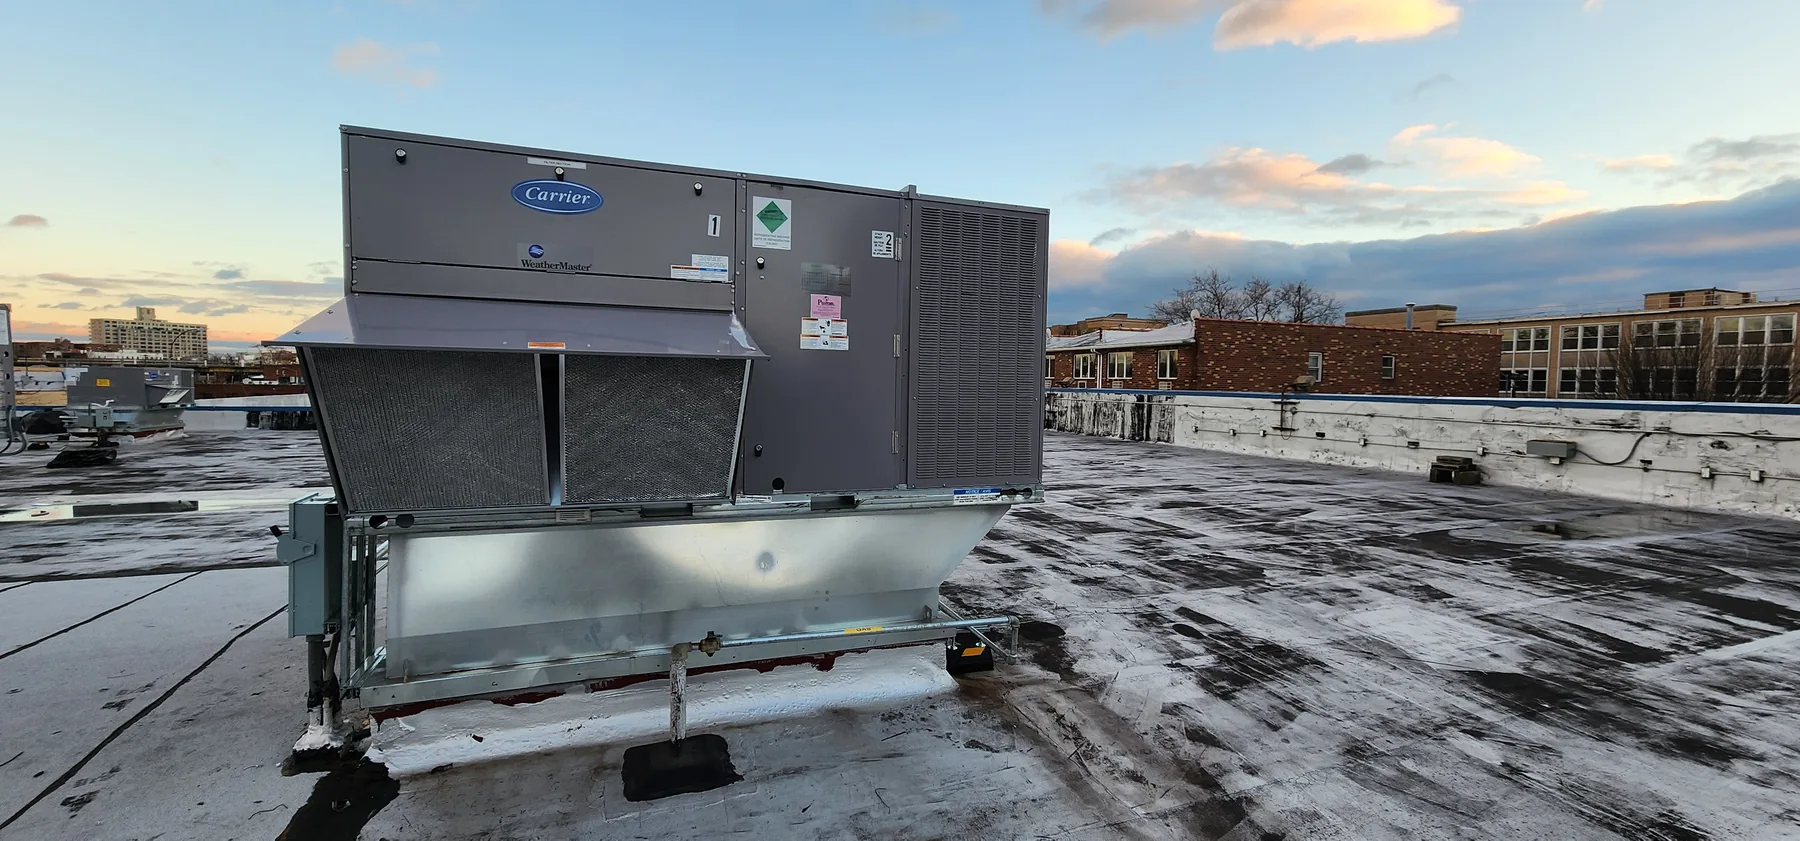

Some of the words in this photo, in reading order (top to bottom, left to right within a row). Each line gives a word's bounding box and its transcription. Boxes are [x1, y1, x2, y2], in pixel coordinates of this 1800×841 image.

[525, 186, 591, 204] Carrier
[712, 216, 718, 236] 1
[885, 233, 892, 246] 2
